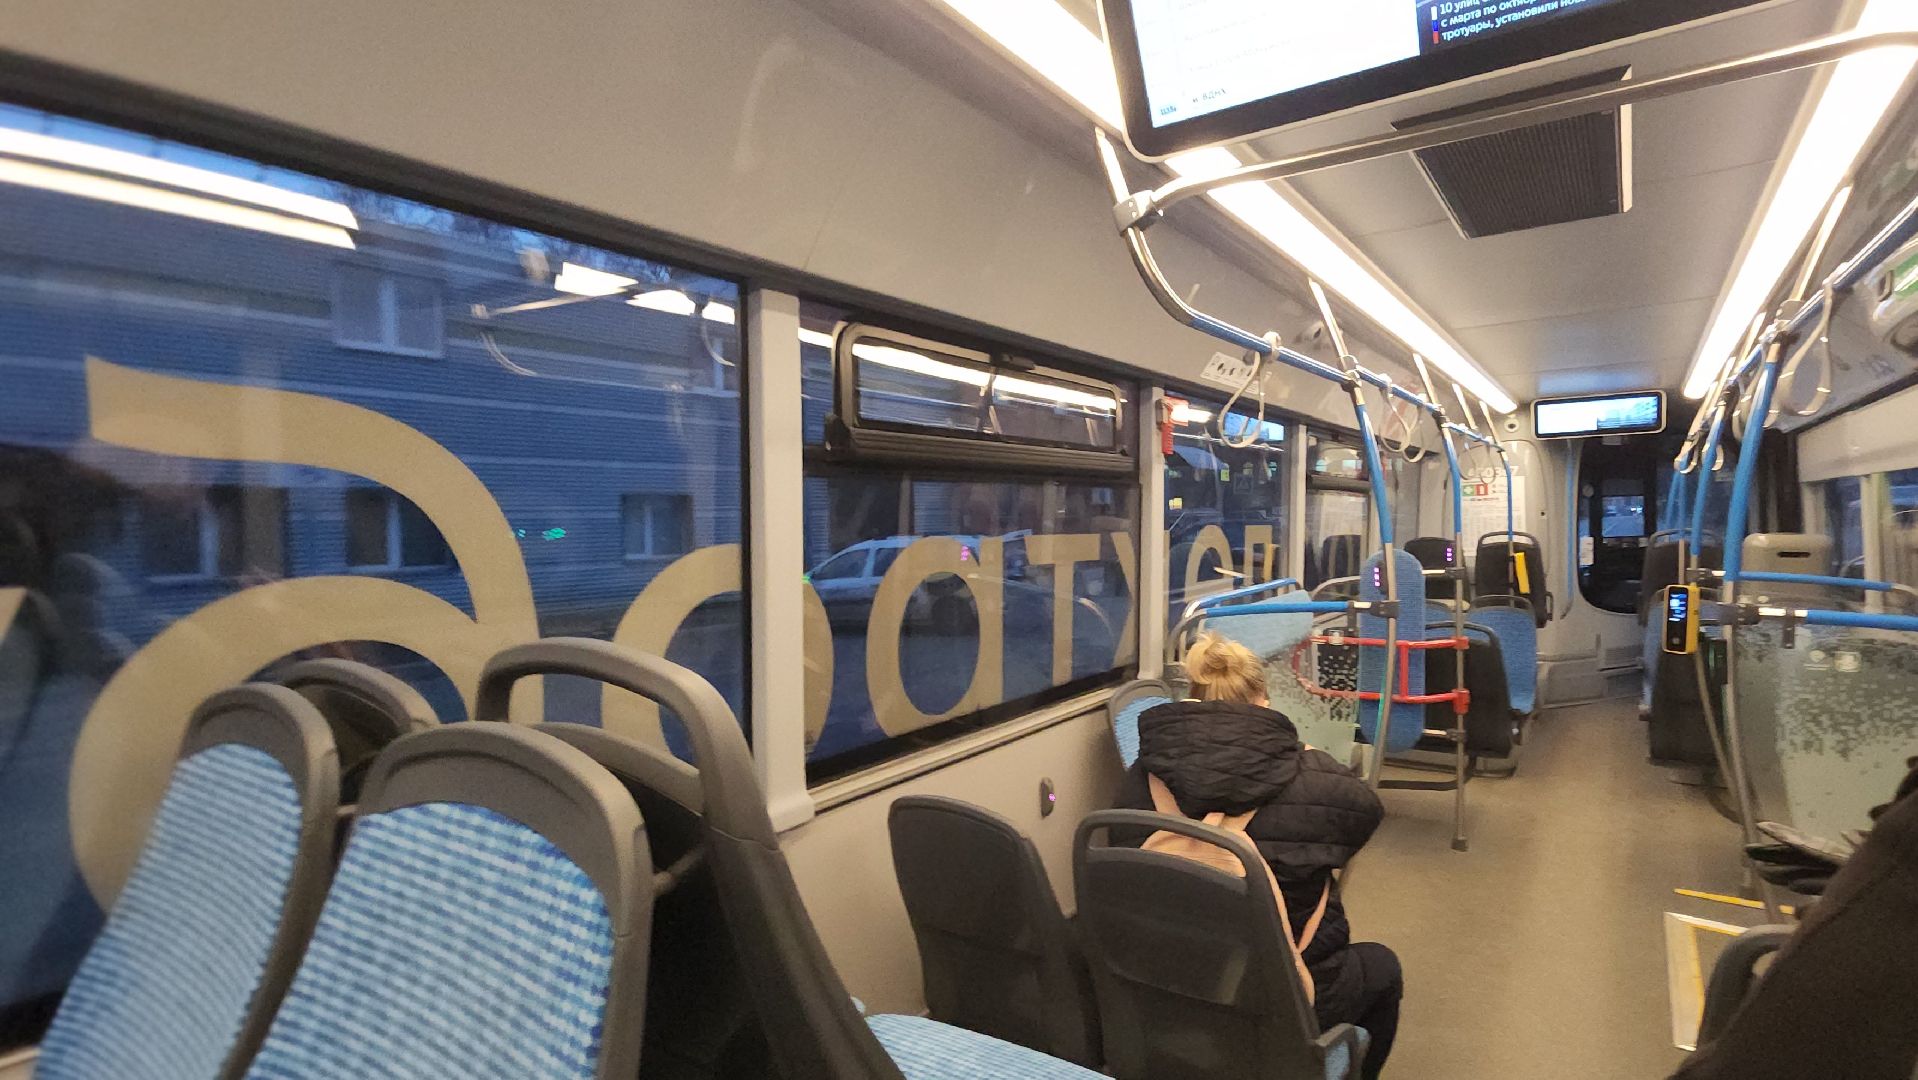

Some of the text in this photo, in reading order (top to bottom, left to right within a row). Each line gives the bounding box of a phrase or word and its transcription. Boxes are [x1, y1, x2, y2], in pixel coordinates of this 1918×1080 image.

[1440, 0, 1480, 14] 10 улиц
[1440, 0, 1537, 27] с марта по октя
[1442, 20, 1494, 41] тротуары,
[1495, 1, 1559, 28] установили
